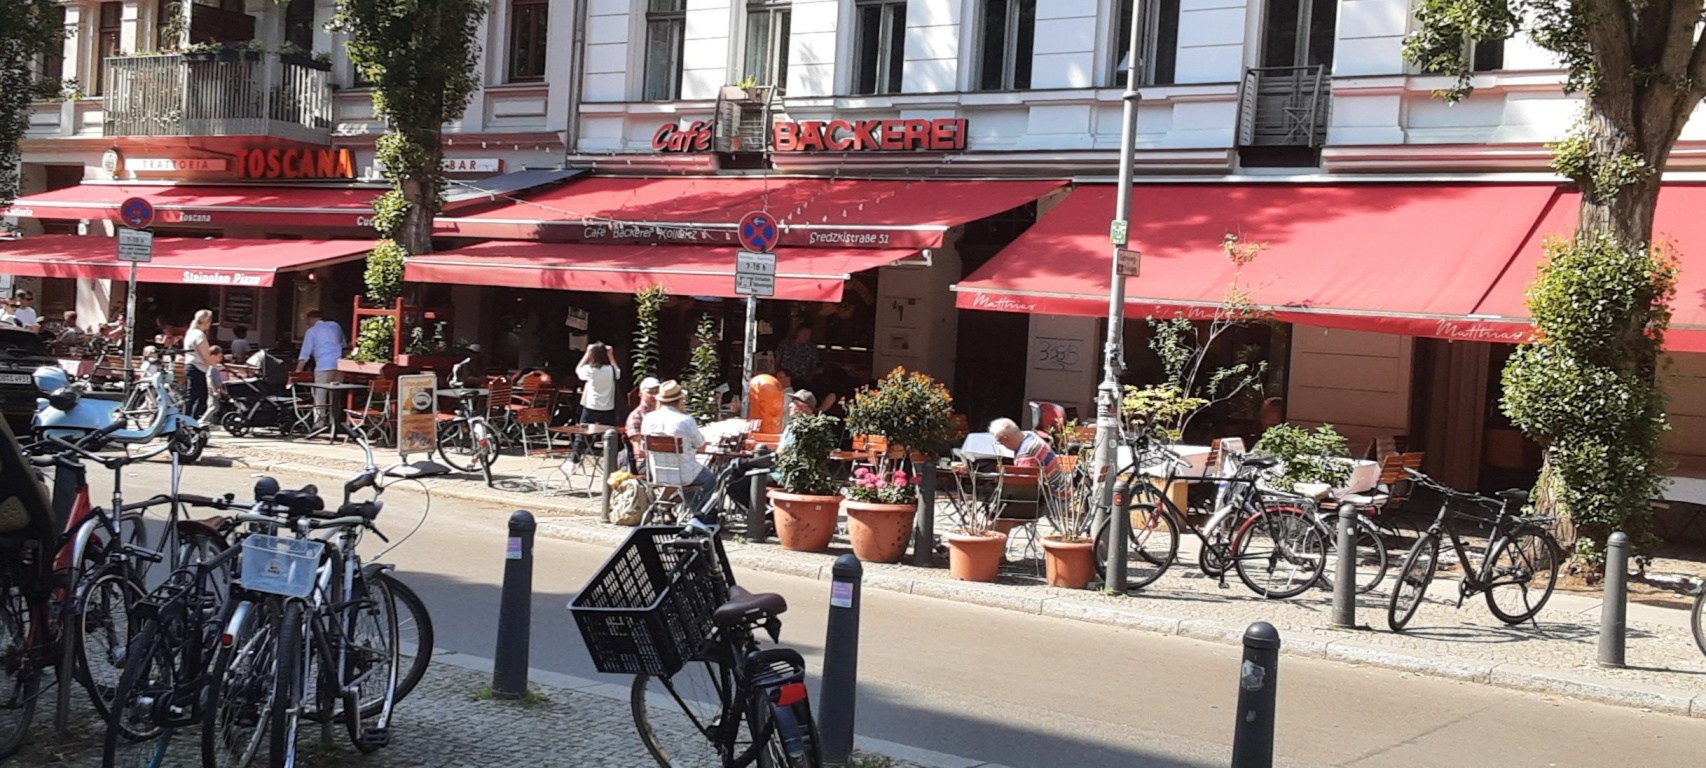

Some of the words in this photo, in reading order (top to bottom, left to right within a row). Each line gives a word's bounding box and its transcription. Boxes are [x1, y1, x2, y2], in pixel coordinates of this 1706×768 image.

[651, 118, 715, 153] Café
[142, 159, 210, 170] TRATTORIA
[236, 148, 354, 178] TOSCANA
[449, 160, 477, 171] BAR
[180, 211, 211, 222] Toscana
[583, 226, 607, 239] Café
[972, 291, 1037, 311] Matthias
[1436, 319, 1523, 340] Matthias
